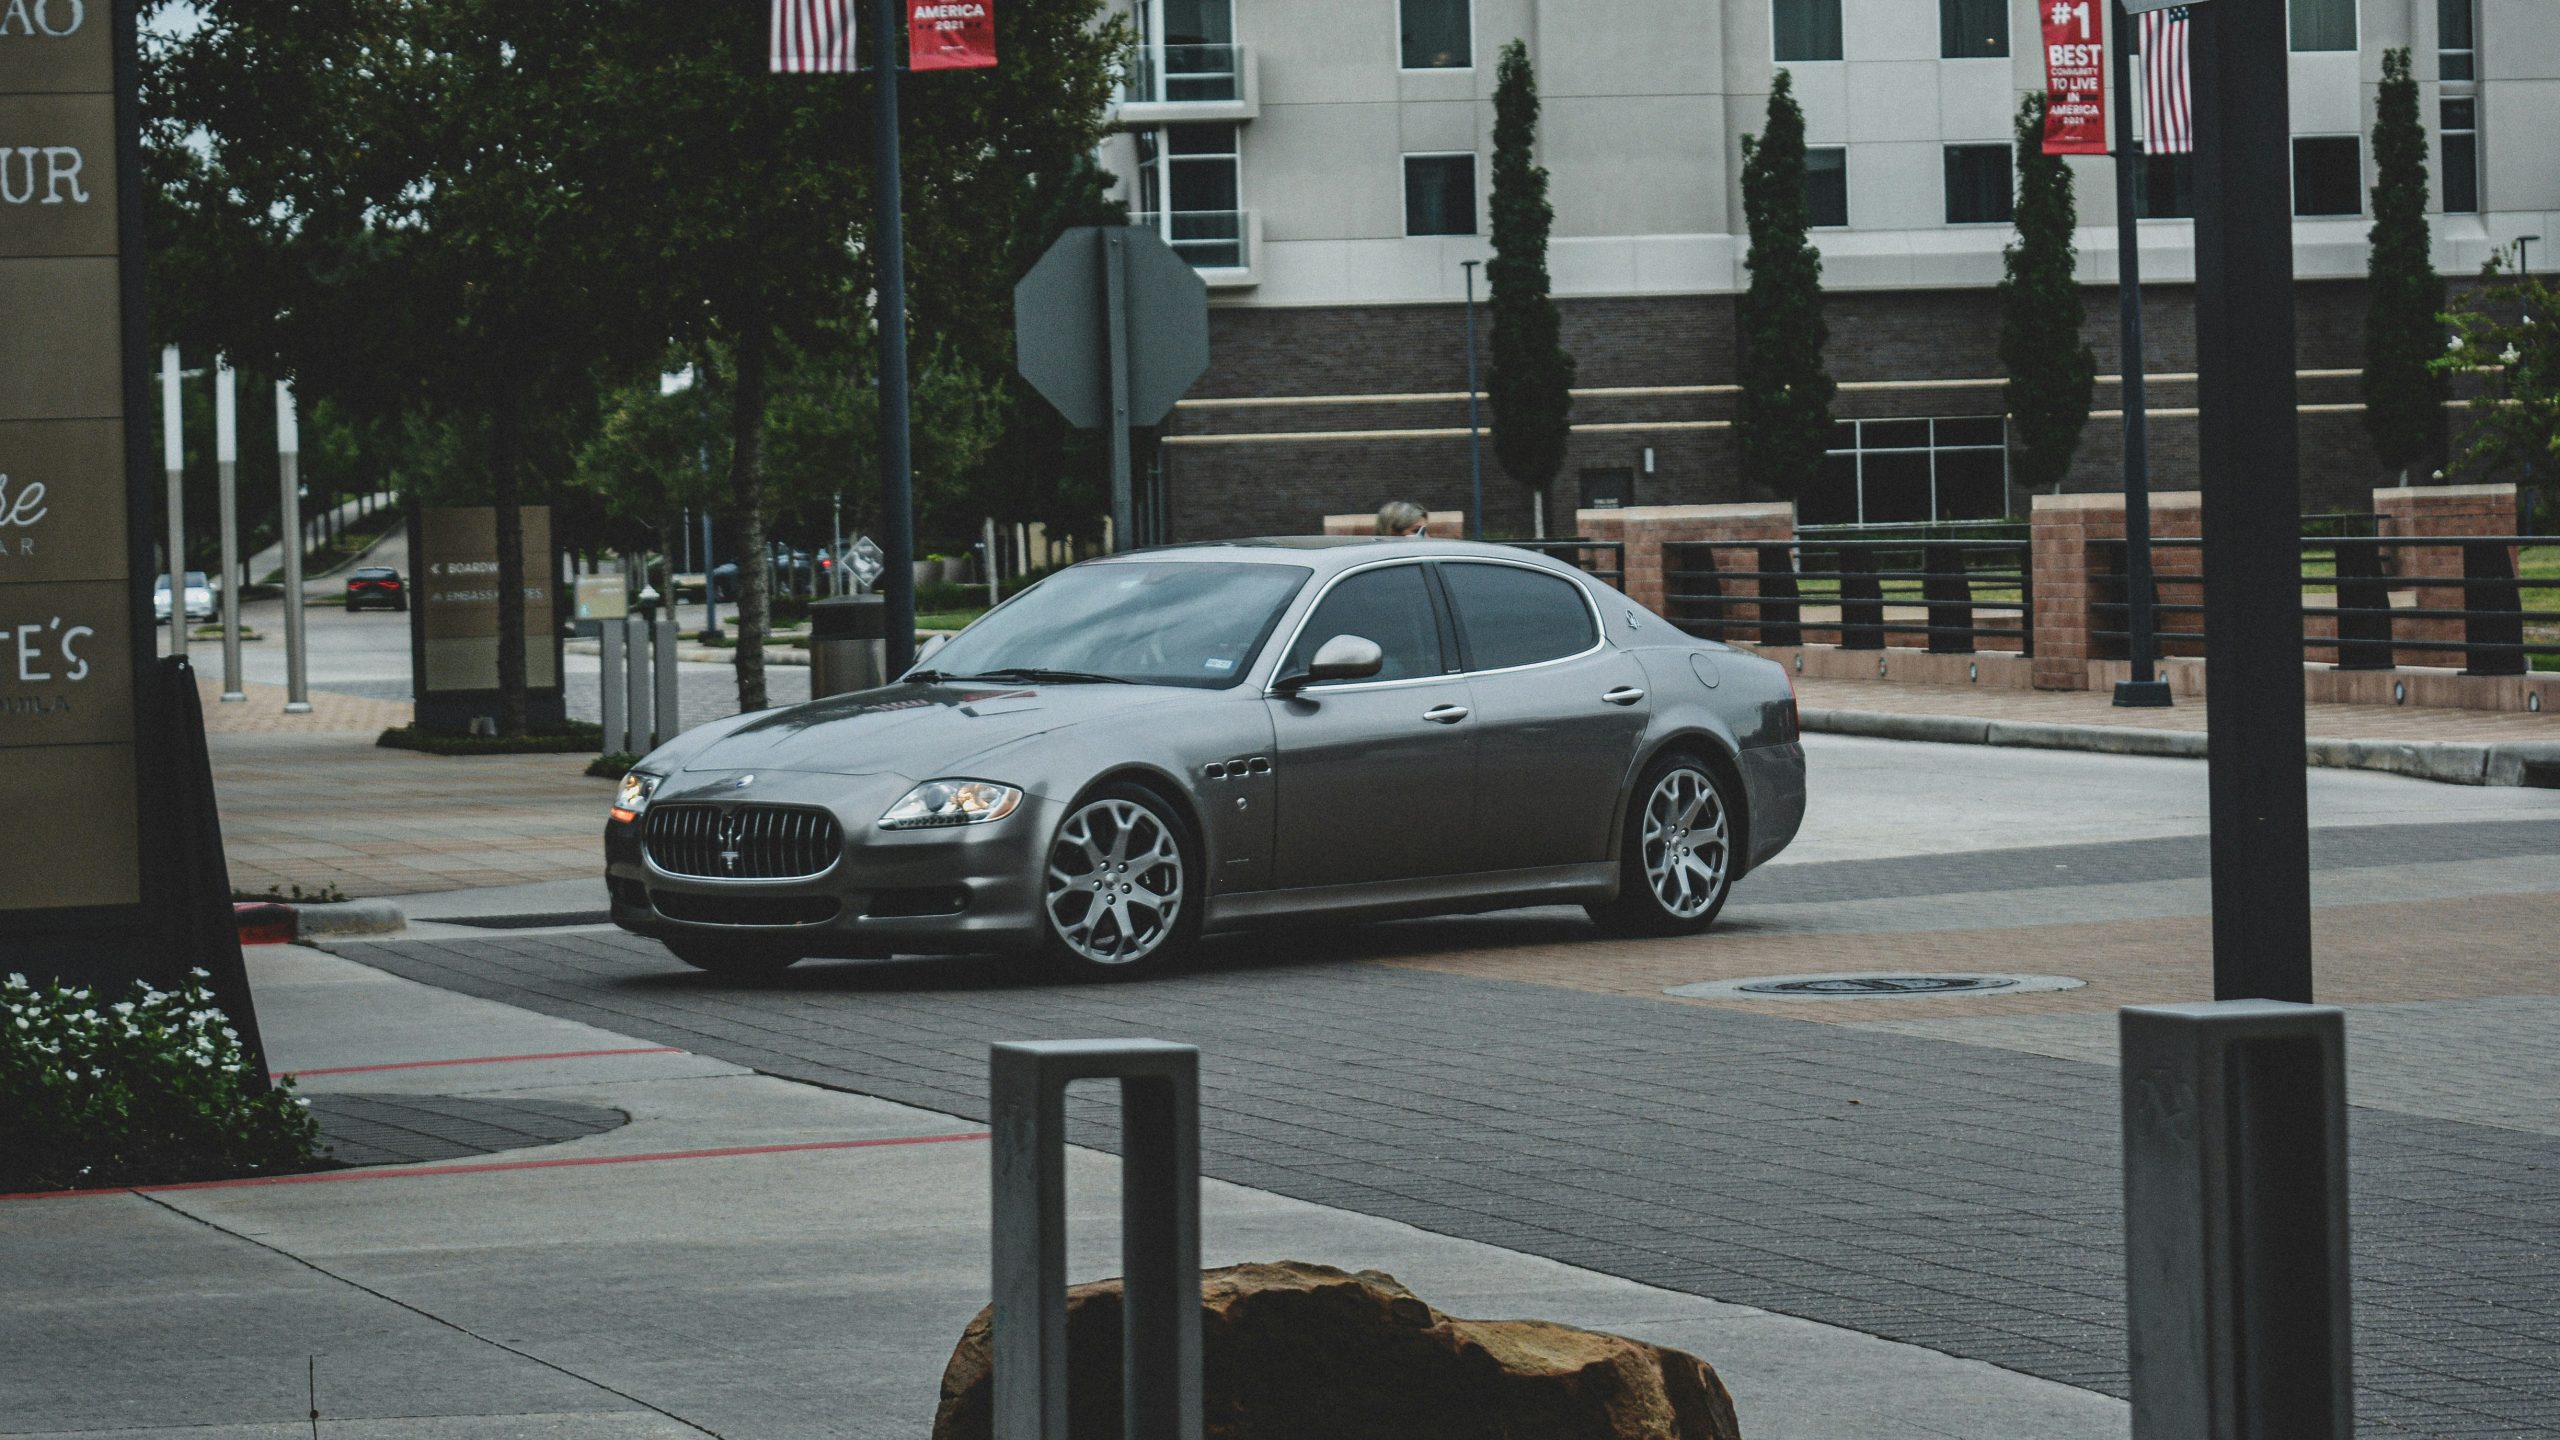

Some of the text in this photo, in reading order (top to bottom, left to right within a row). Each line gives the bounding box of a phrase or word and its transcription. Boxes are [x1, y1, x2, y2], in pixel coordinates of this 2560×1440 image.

[914, 3, 985, 19] AMERICA
[935, 20, 964, 31] 2021
[2051, 2, 2090, 39] #1
[2049, 44, 2101, 66] BEST
[2052, 77, 2098, 90] TO LIVE
[2067, 92, 2080, 102] IN
[2049, 104, 2099, 115] AMERICA
[2063, 116, 2085, 125] 2021
